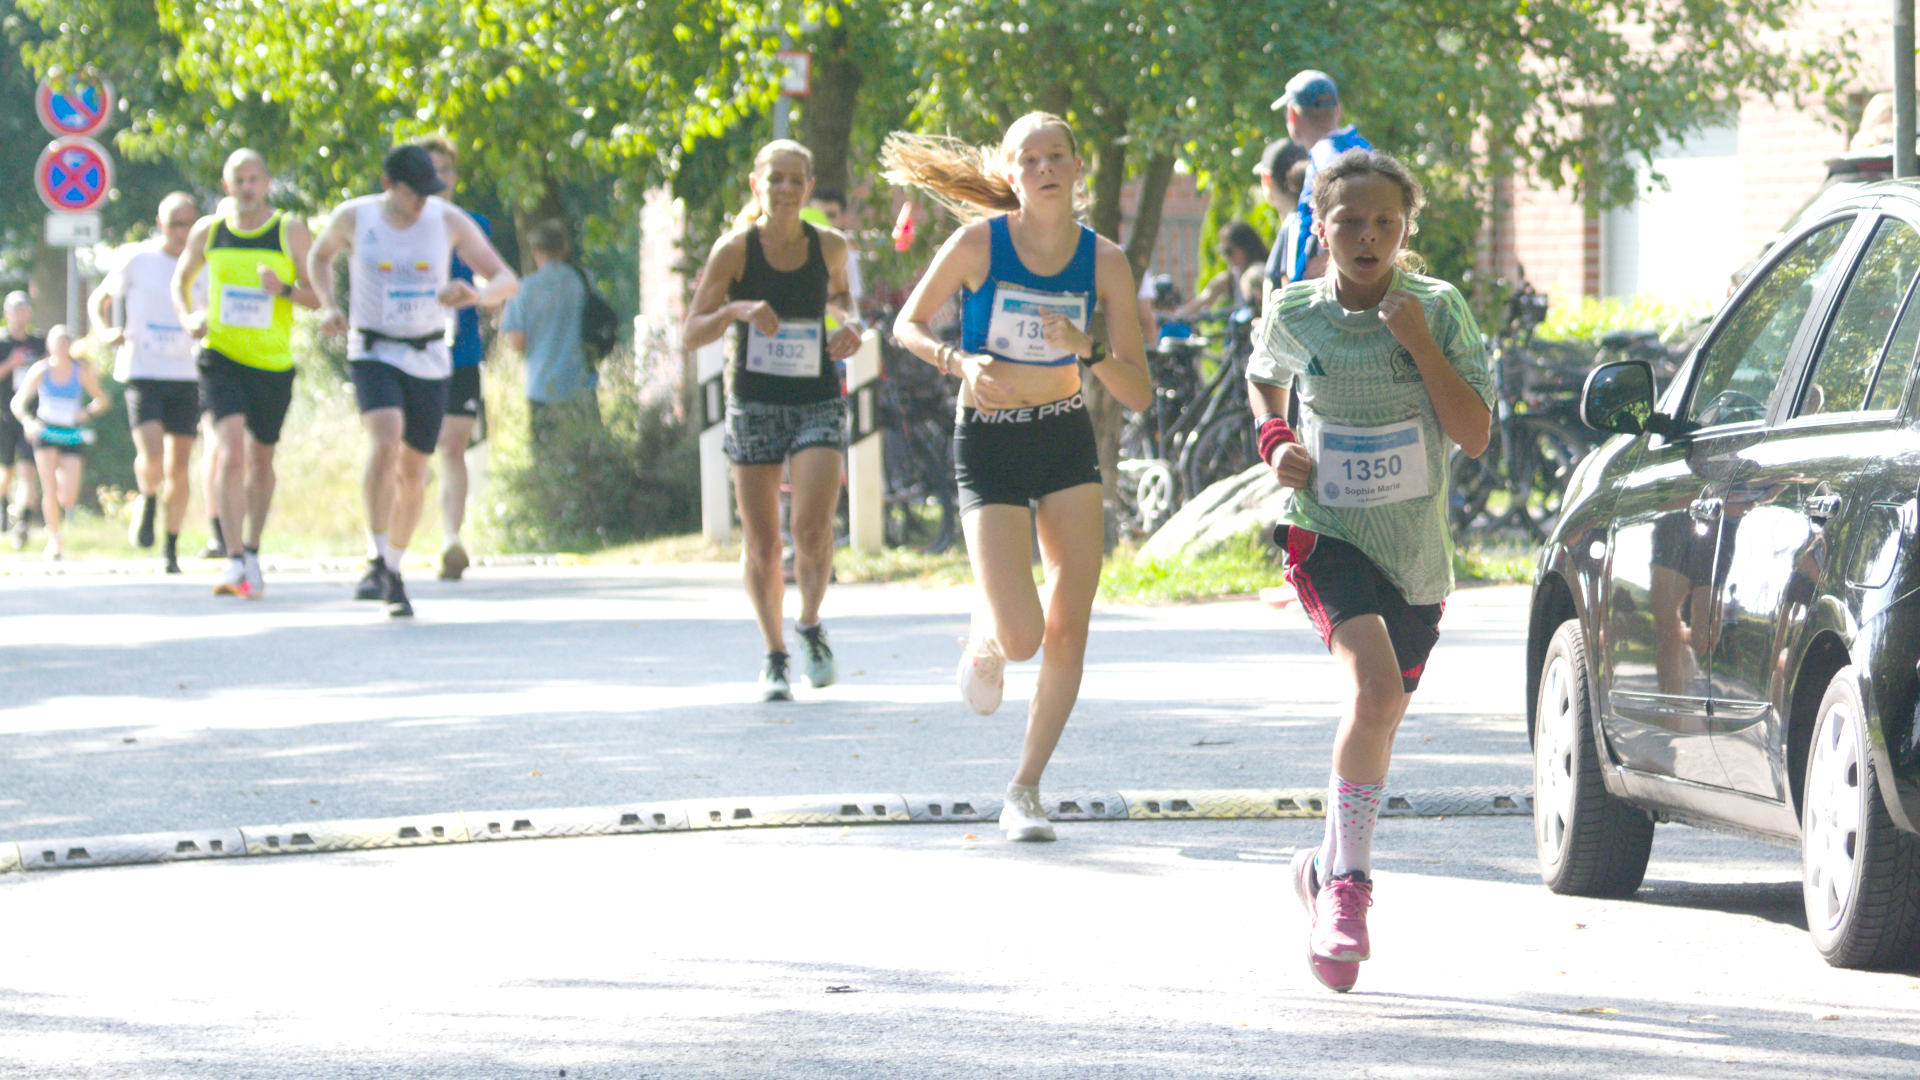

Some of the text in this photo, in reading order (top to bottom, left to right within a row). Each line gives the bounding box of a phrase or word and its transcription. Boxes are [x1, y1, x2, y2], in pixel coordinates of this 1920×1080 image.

[765, 341, 805, 359] 1832
[970, 393, 1083, 424] NIKE PRO
[1341, 454, 1402, 481] 1350
[1343, 482, 1401, 497] Sophie Marie
